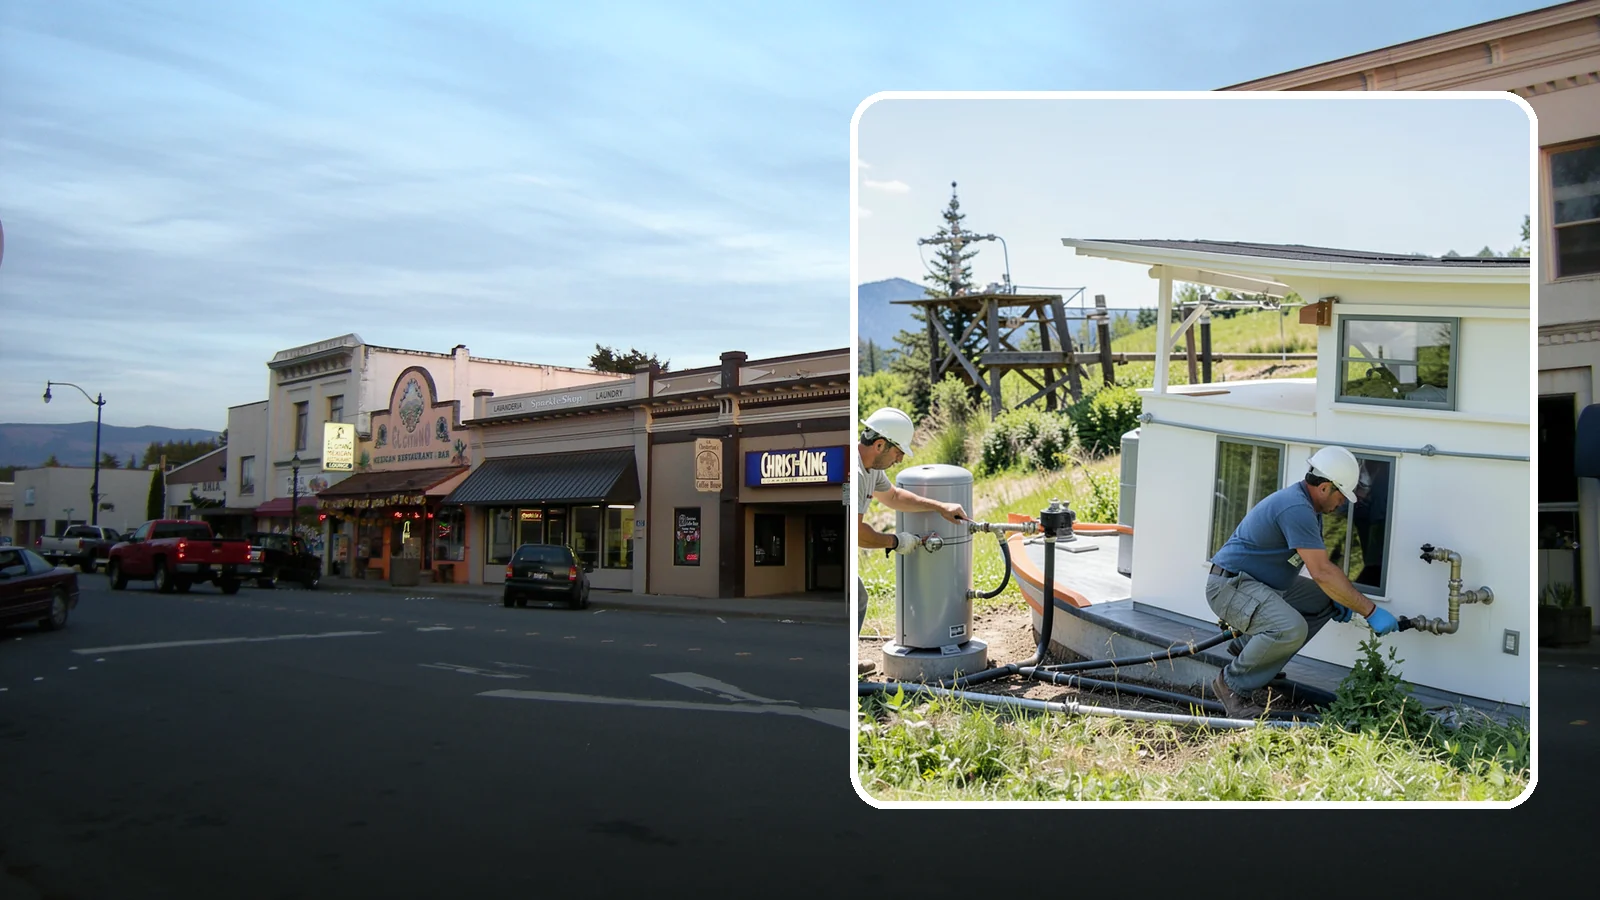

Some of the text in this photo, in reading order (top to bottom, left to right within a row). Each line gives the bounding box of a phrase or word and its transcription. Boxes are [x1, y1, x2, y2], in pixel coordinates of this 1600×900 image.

[595, 389, 624, 400] LAUNDRY
[493, 402, 522, 412] LAVANDERIA
[531, 394, 582, 409] Sparkle Shop
[397, 451, 434, 462] RESTAURANT
[438, 450, 450, 459] BAR
